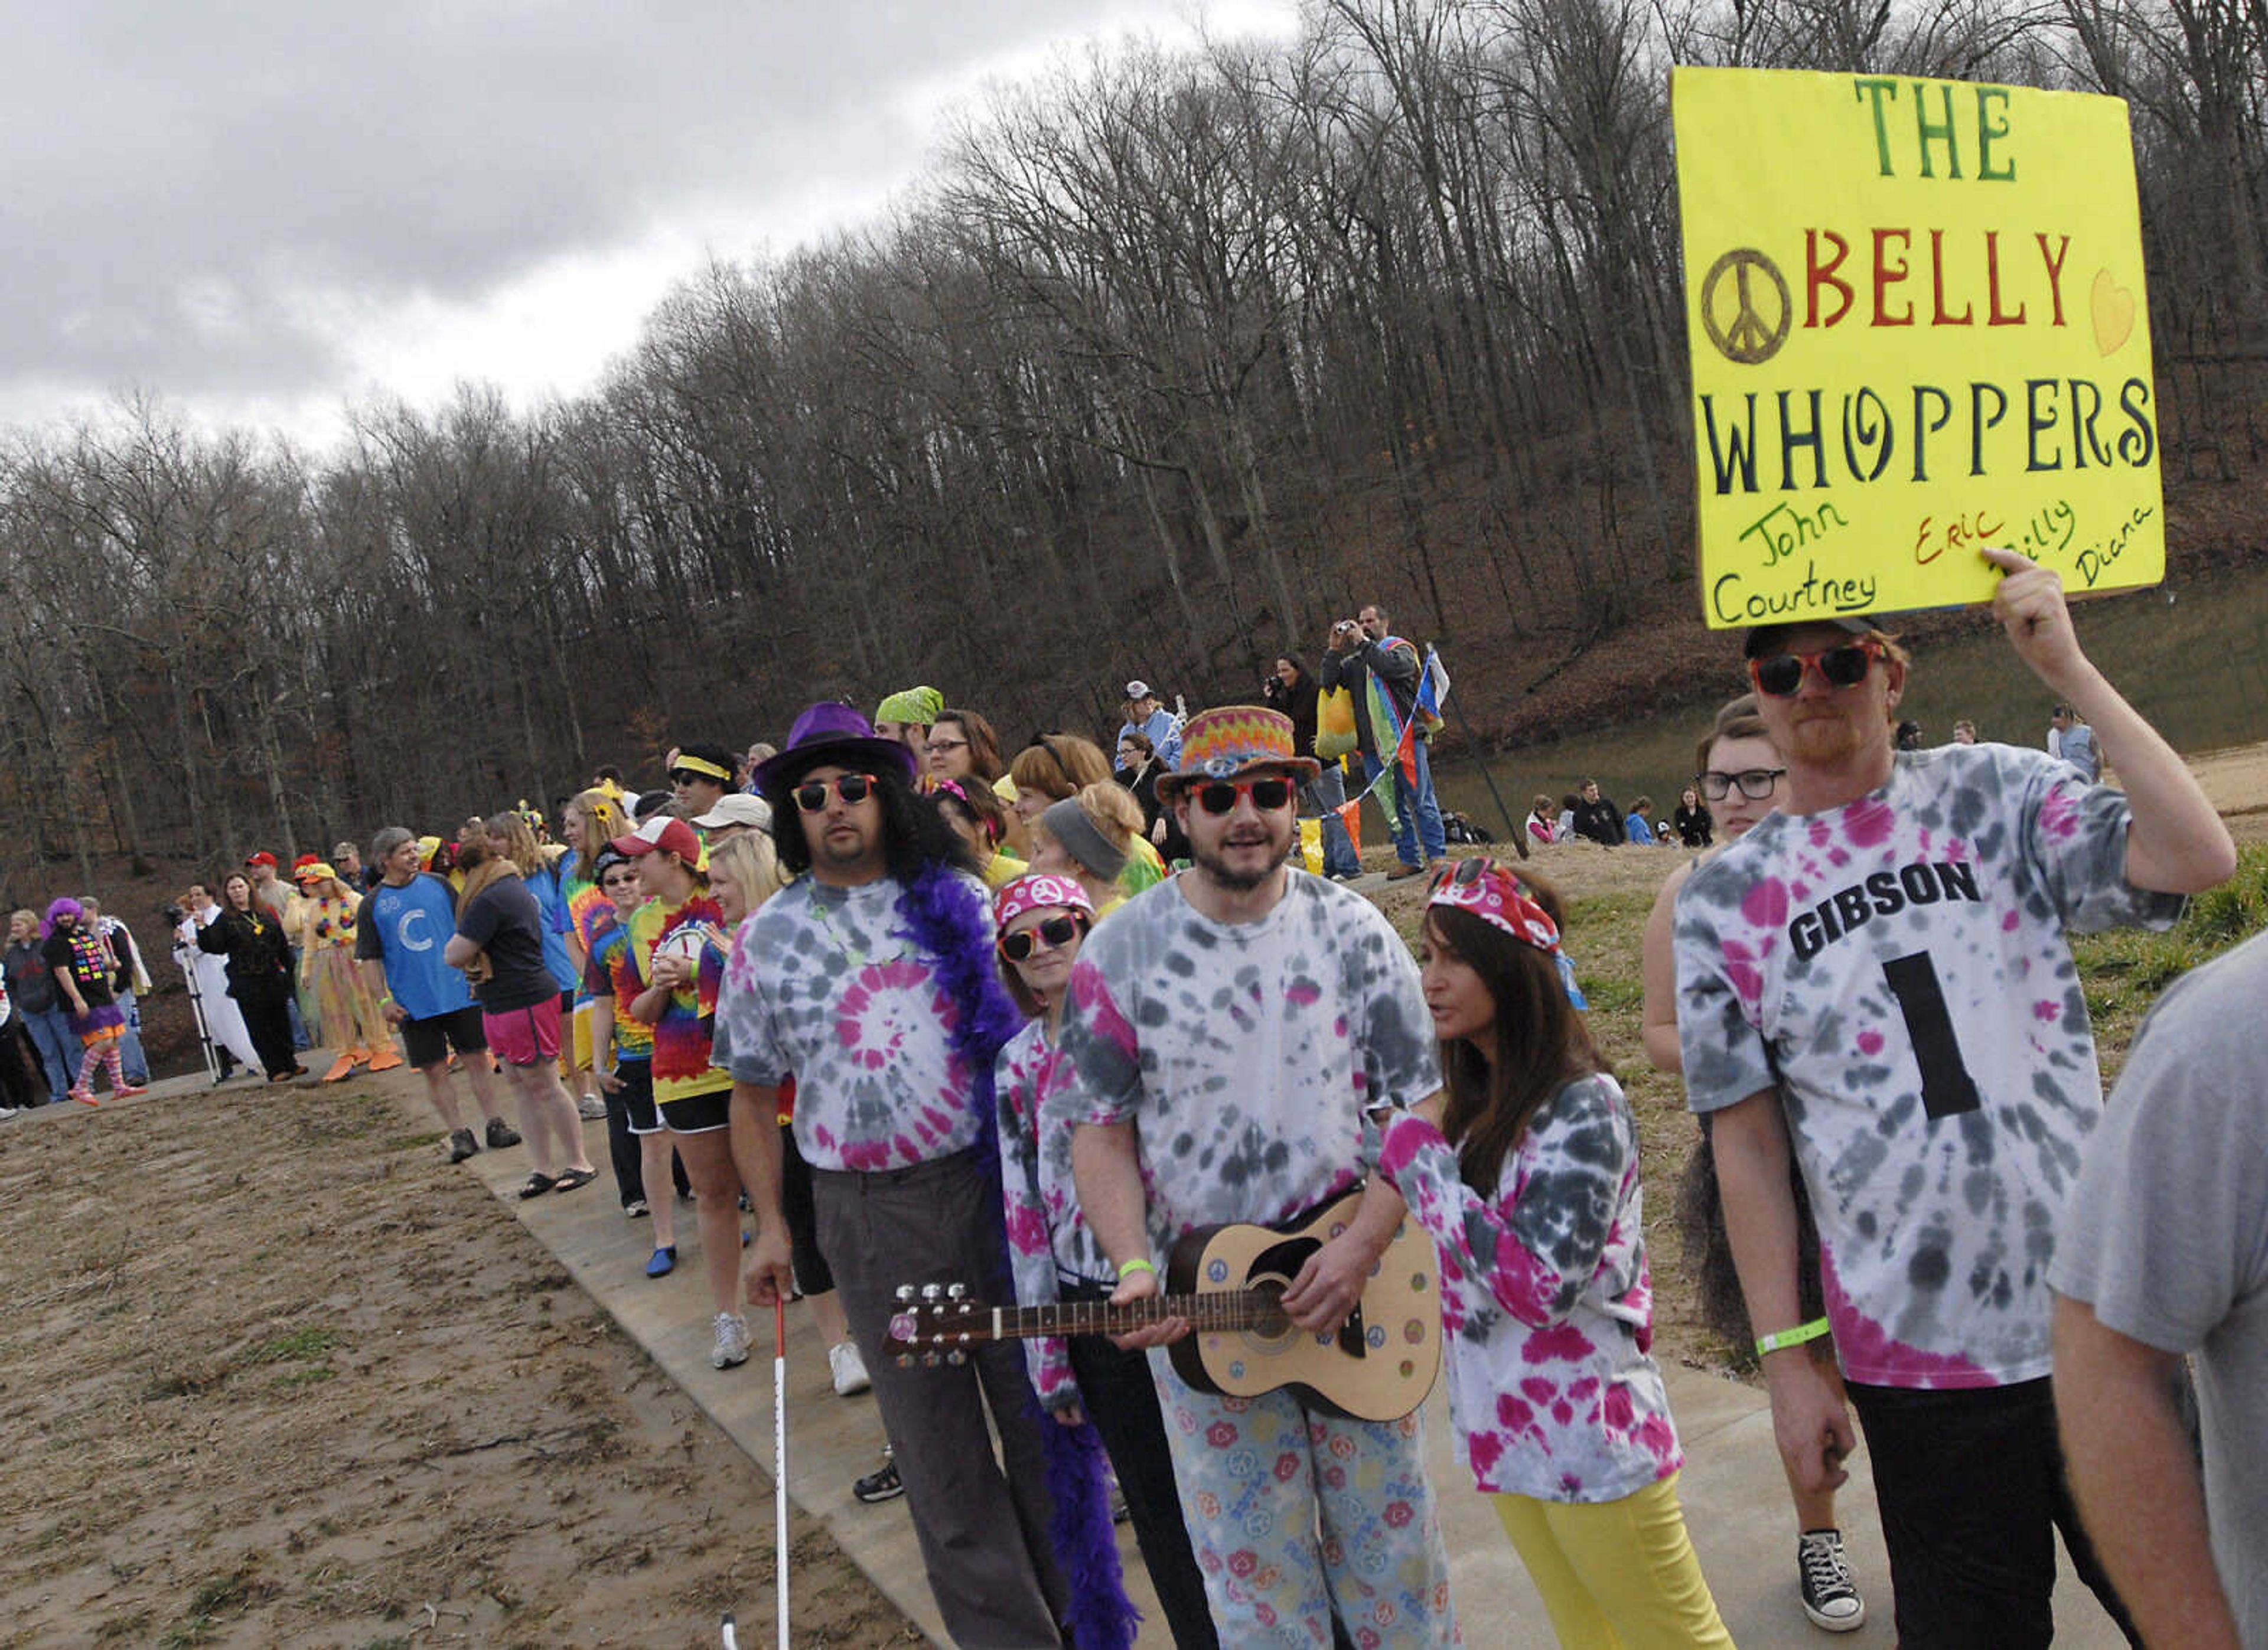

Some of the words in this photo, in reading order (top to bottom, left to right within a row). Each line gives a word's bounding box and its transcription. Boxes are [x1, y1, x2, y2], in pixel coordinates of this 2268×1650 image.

[1855, 79, 2017, 181] THE
[1803, 227, 2070, 328] BELLY
[1699, 377, 2155, 495] WHOPPERS
[1739, 501, 1849, 566] John
[1989, 500, 2075, 576] illy
[2075, 507, 2153, 587] Diana
[1714, 559, 1875, 622] Courtney
[397, 908, 434, 953] C
[1788, 861, 1982, 963] GIBSON
[1882, 950, 1981, 1121] 1
